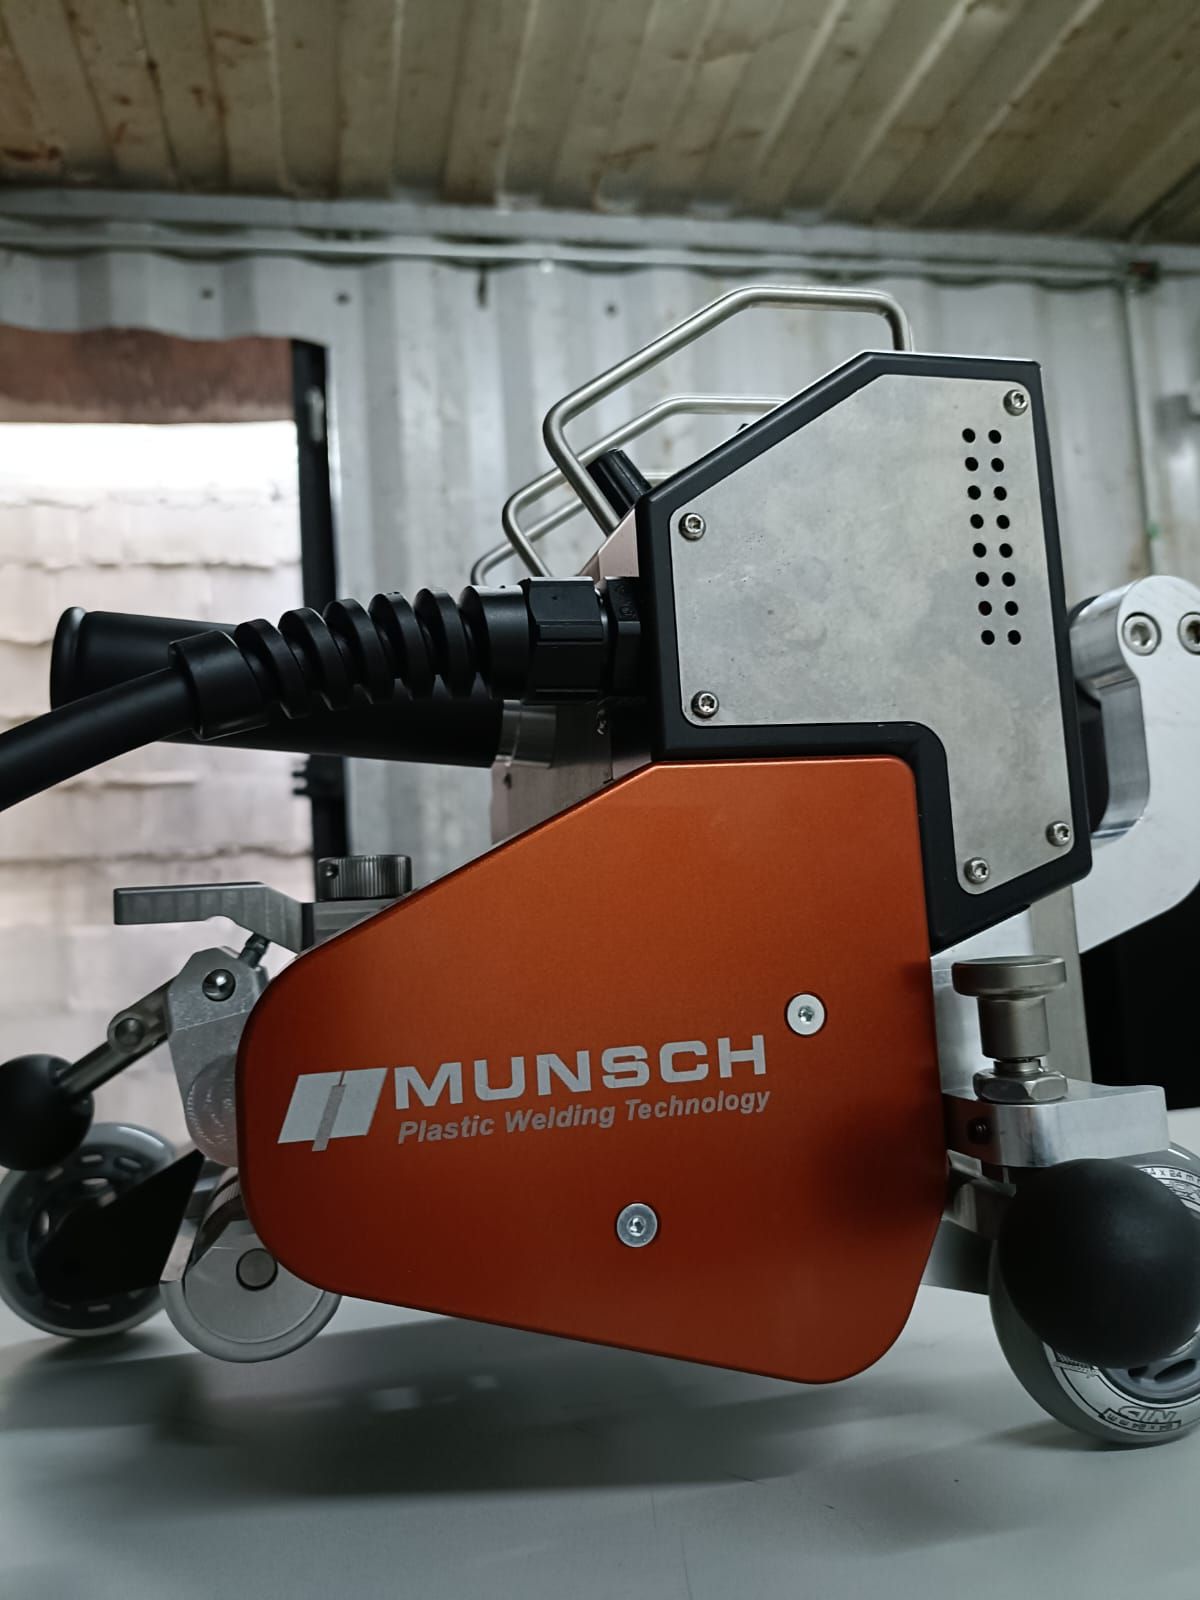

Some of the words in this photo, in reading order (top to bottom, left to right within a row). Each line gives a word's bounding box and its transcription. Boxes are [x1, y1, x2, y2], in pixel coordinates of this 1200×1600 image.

[394, 1034, 767, 1110] MUNSCH
[398, 1114, 496, 1144] Plastic
[505, 1104, 616, 1133] Welding
[625, 1090, 771, 1121] Technology
